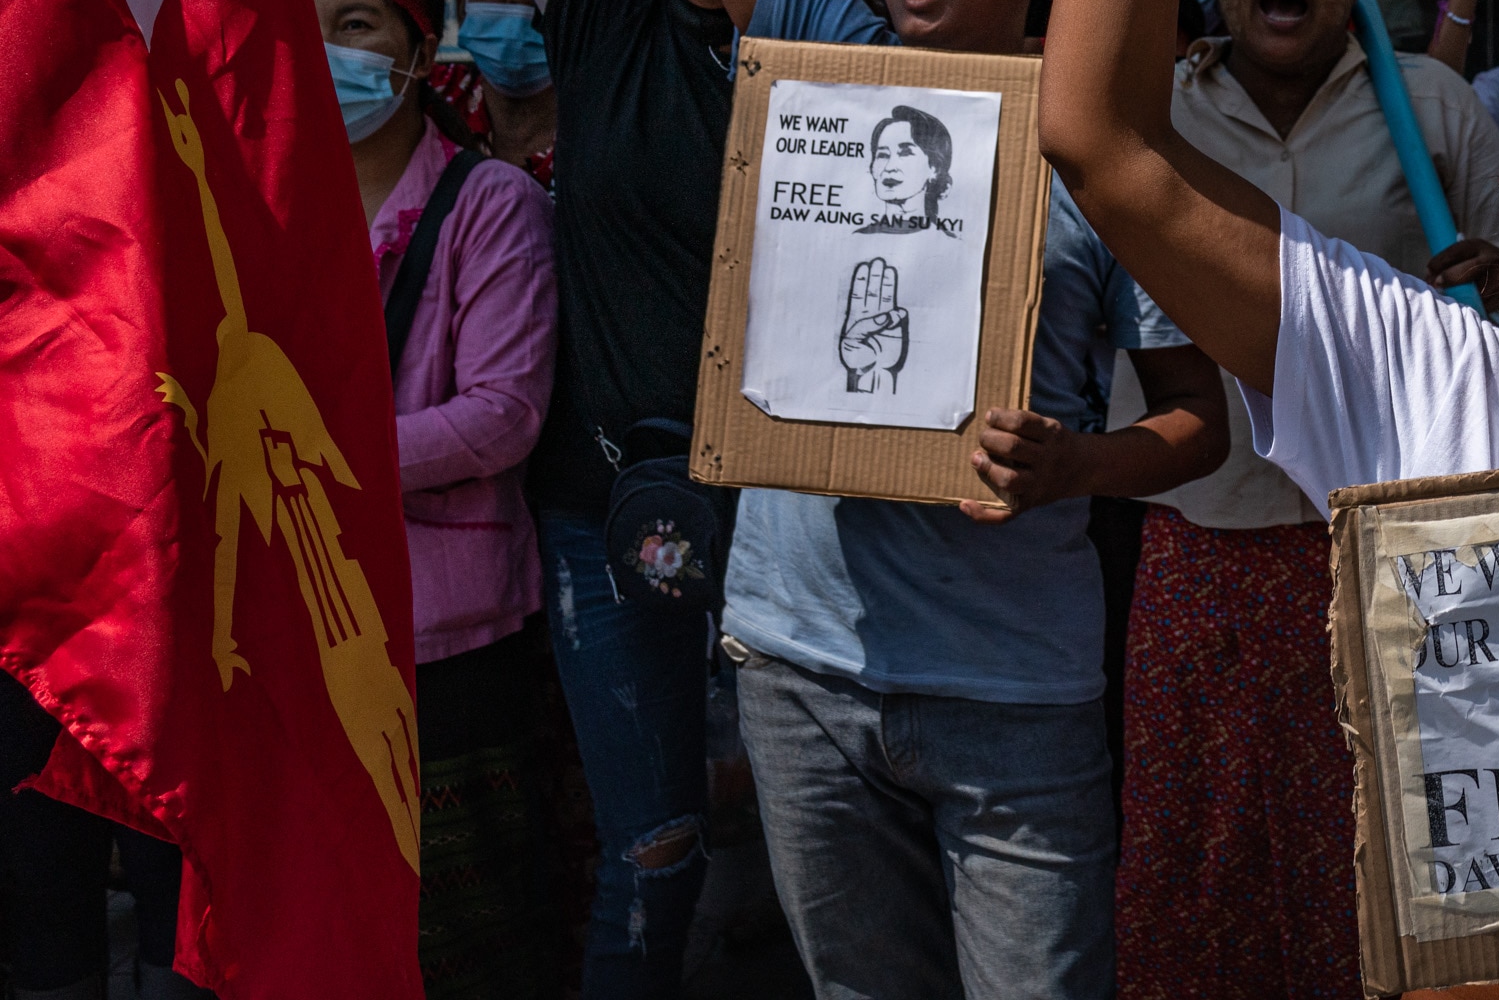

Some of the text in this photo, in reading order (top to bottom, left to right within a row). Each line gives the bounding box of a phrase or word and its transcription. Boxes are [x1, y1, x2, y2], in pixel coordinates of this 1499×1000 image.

[780, 114, 848, 134] WE WANT
[776, 137, 865, 158] OUR LEADER
[773, 181, 844, 207] FREE
[770, 207, 963, 232] DAW AUNG SAN SU KYI
